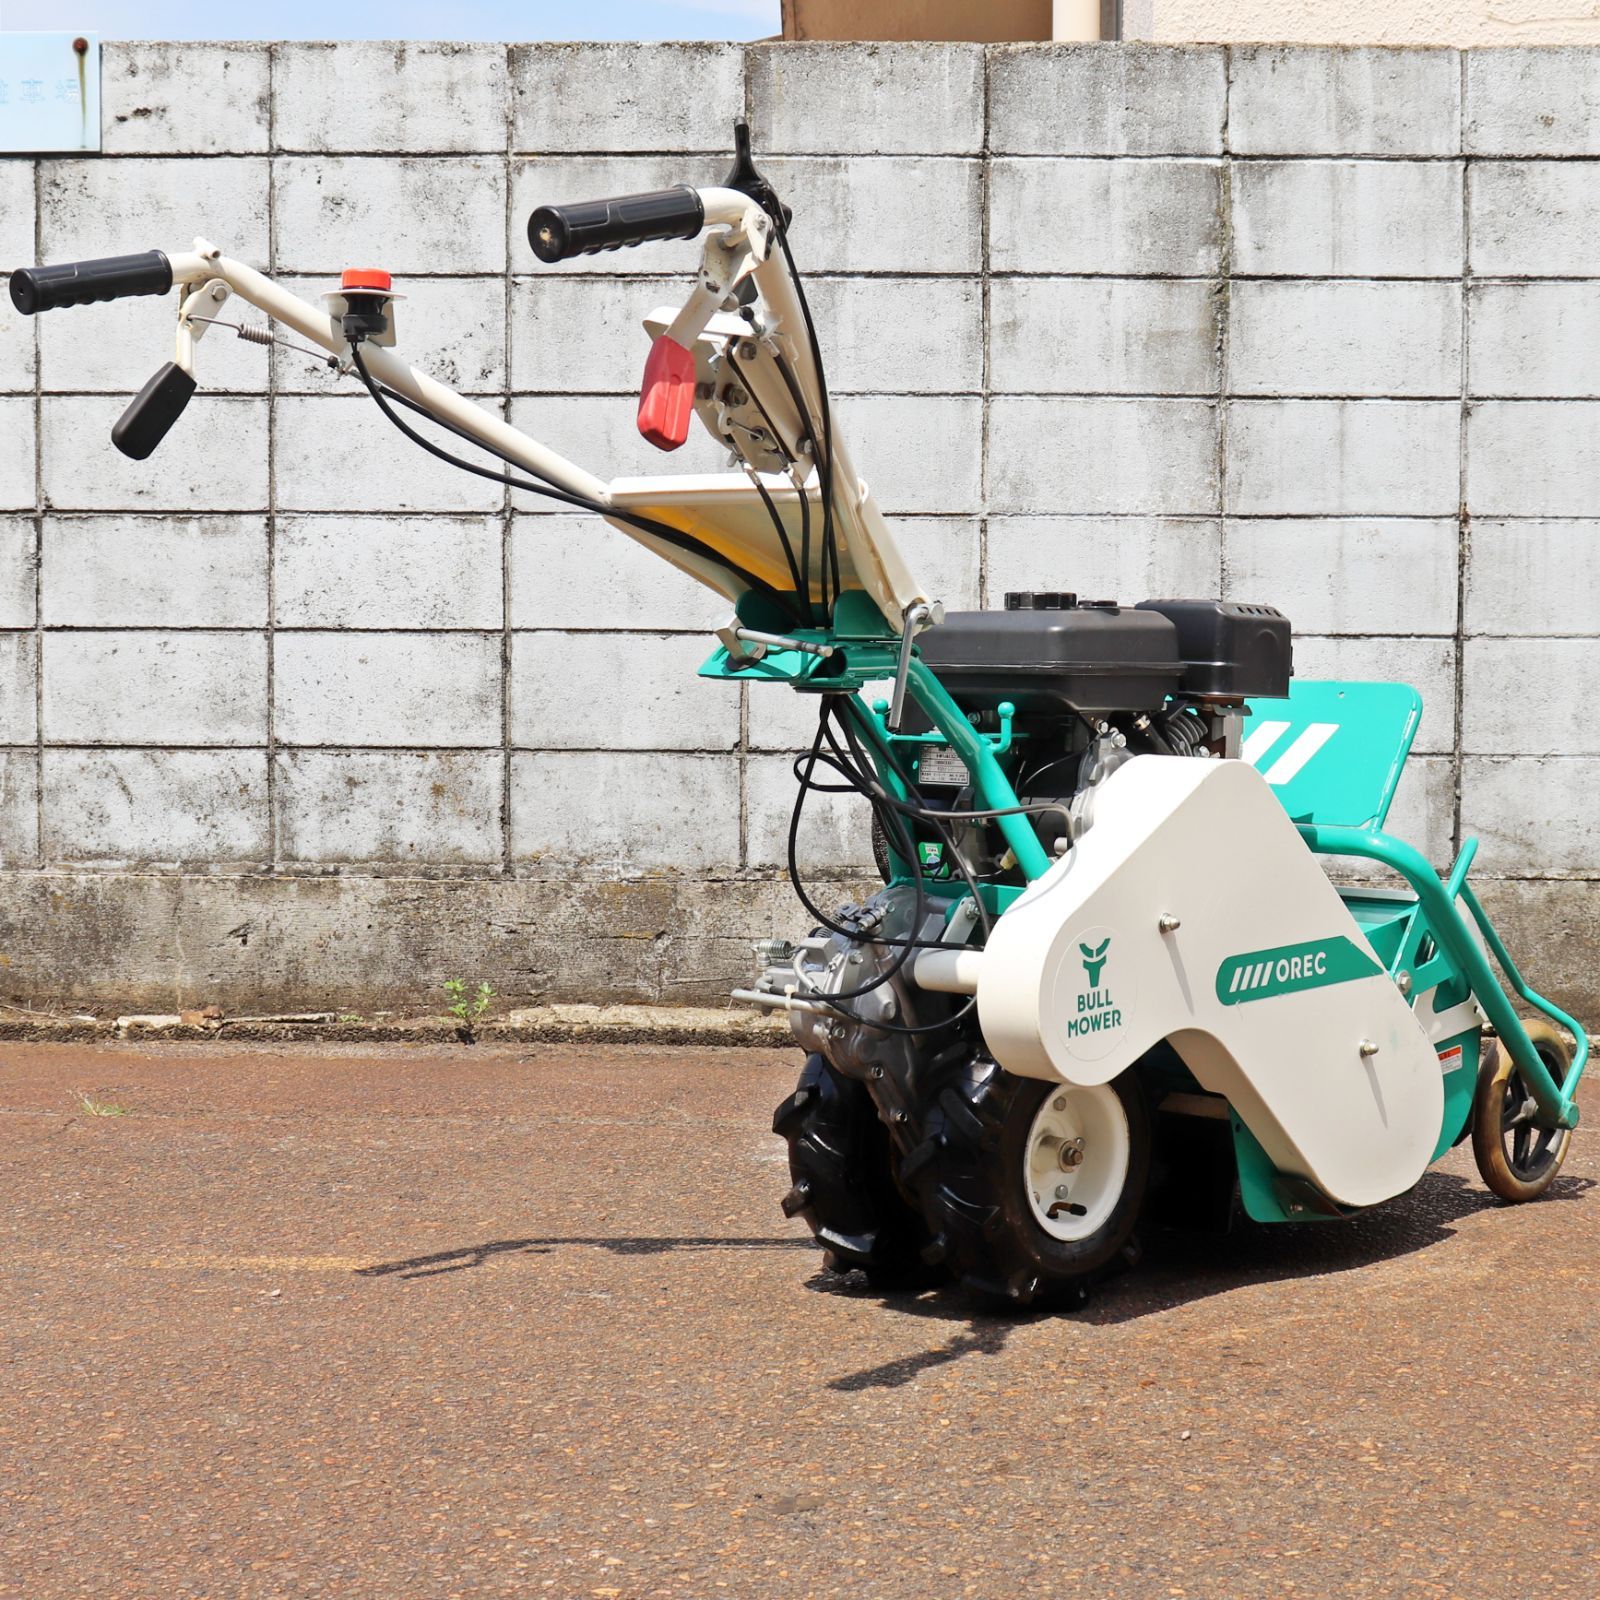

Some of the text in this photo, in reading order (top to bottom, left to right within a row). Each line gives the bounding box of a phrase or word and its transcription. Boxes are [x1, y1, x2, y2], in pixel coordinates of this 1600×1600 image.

[1275, 951, 1327, 983] OREC
[1077, 989, 1113, 1013] BULL
[1067, 1009, 1122, 1038] MOWER
